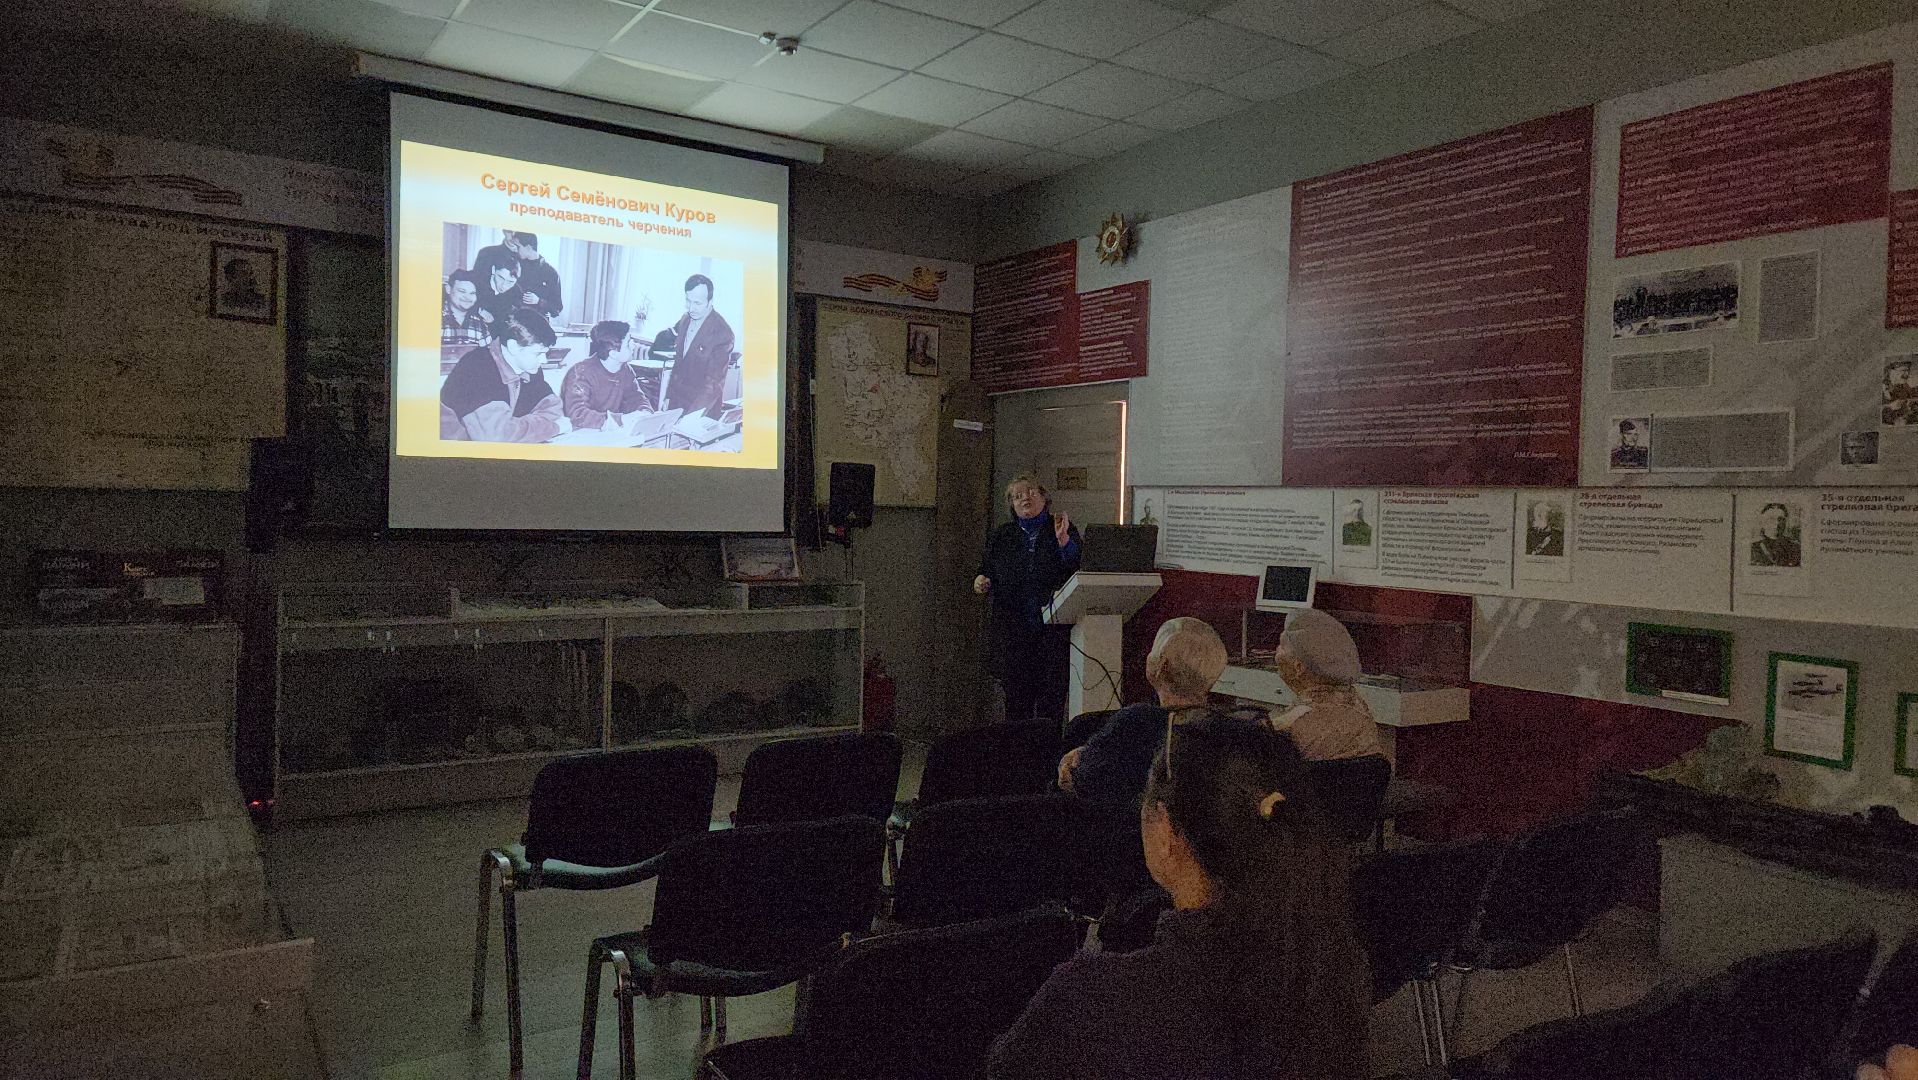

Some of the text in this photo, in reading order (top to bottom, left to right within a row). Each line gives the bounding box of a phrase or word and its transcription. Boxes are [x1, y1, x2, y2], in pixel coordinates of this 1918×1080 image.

[480, 172, 716, 224] Сергей Семёнович Куров
[509, 201, 692, 238] преподаватель черчения
[1598, 493, 1641, 501] отдельная
[1846, 494, 1905, 503] отдельная
[1578, 501, 1664, 510] стрелковая бригада
[1820, 503, 1884, 513] стрелковая
